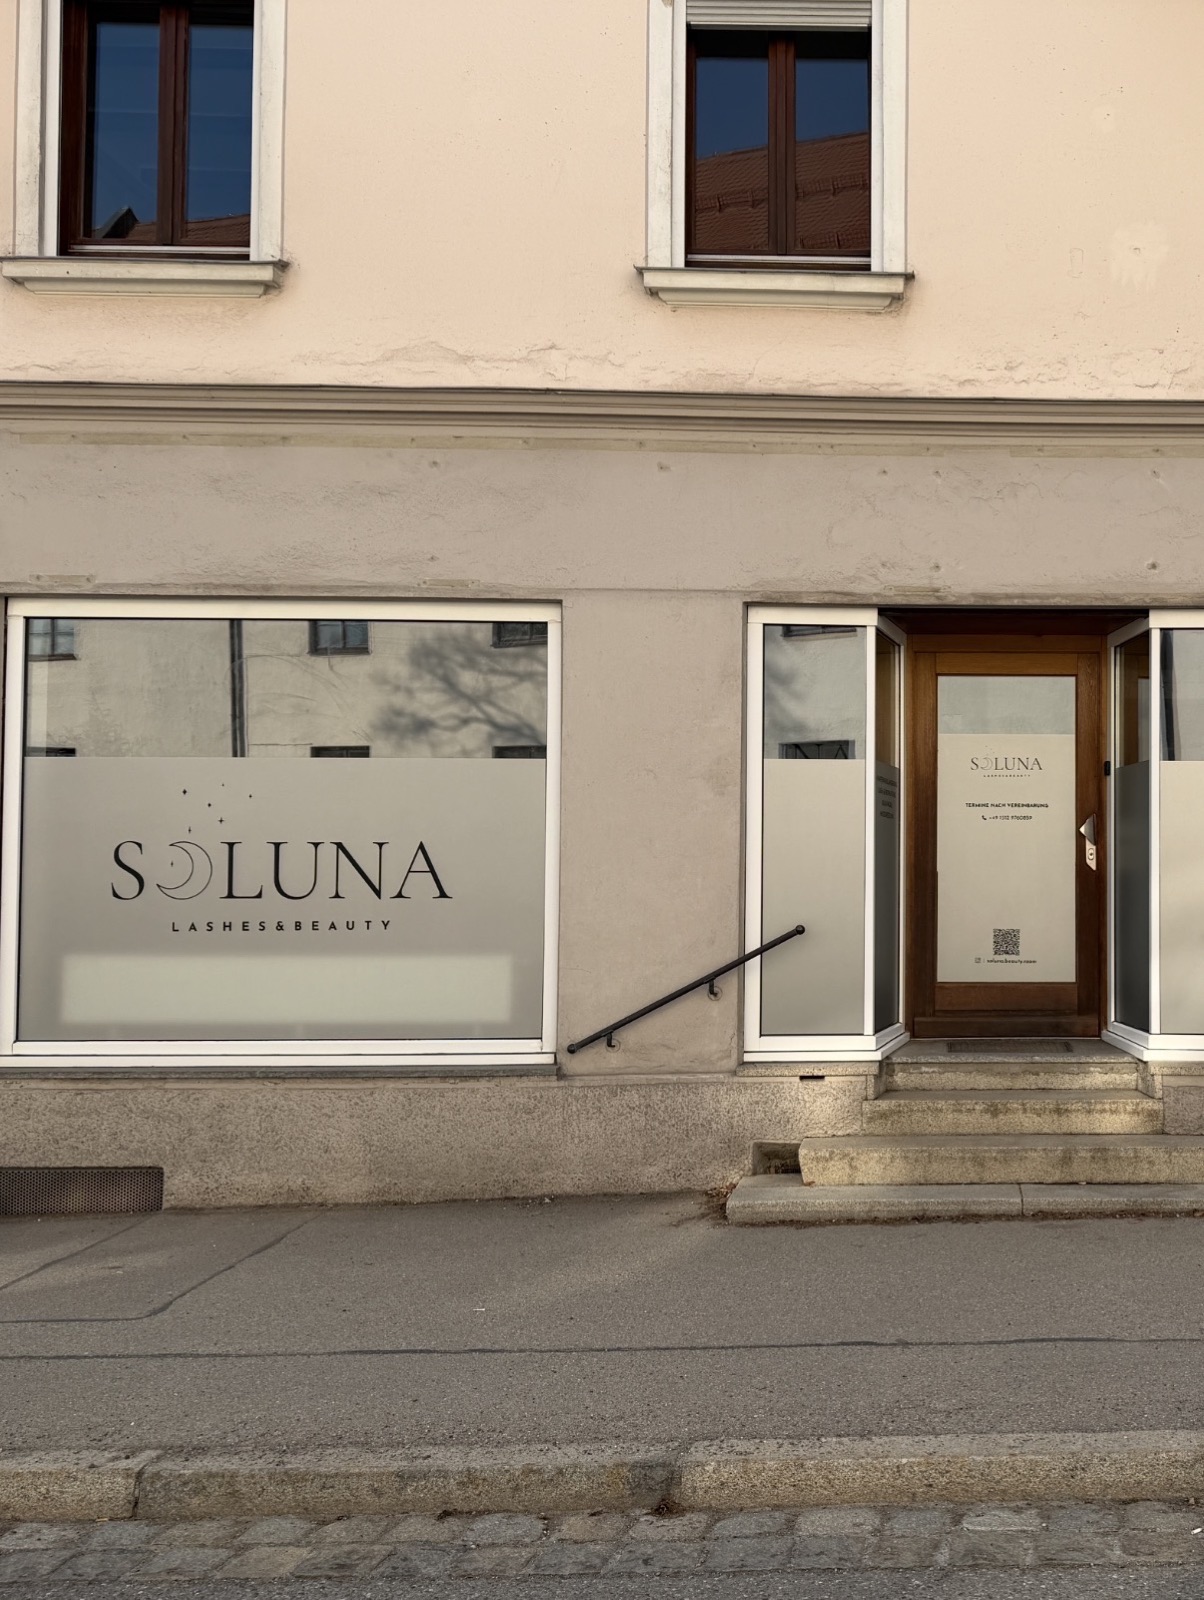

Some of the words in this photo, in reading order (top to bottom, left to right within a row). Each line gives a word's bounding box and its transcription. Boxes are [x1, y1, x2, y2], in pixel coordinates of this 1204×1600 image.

[970, 757, 1043, 771] SOLUNA
[111, 840, 453, 901] SOLUNA
[171, 920, 392, 932] LASHES&BEAUTY
